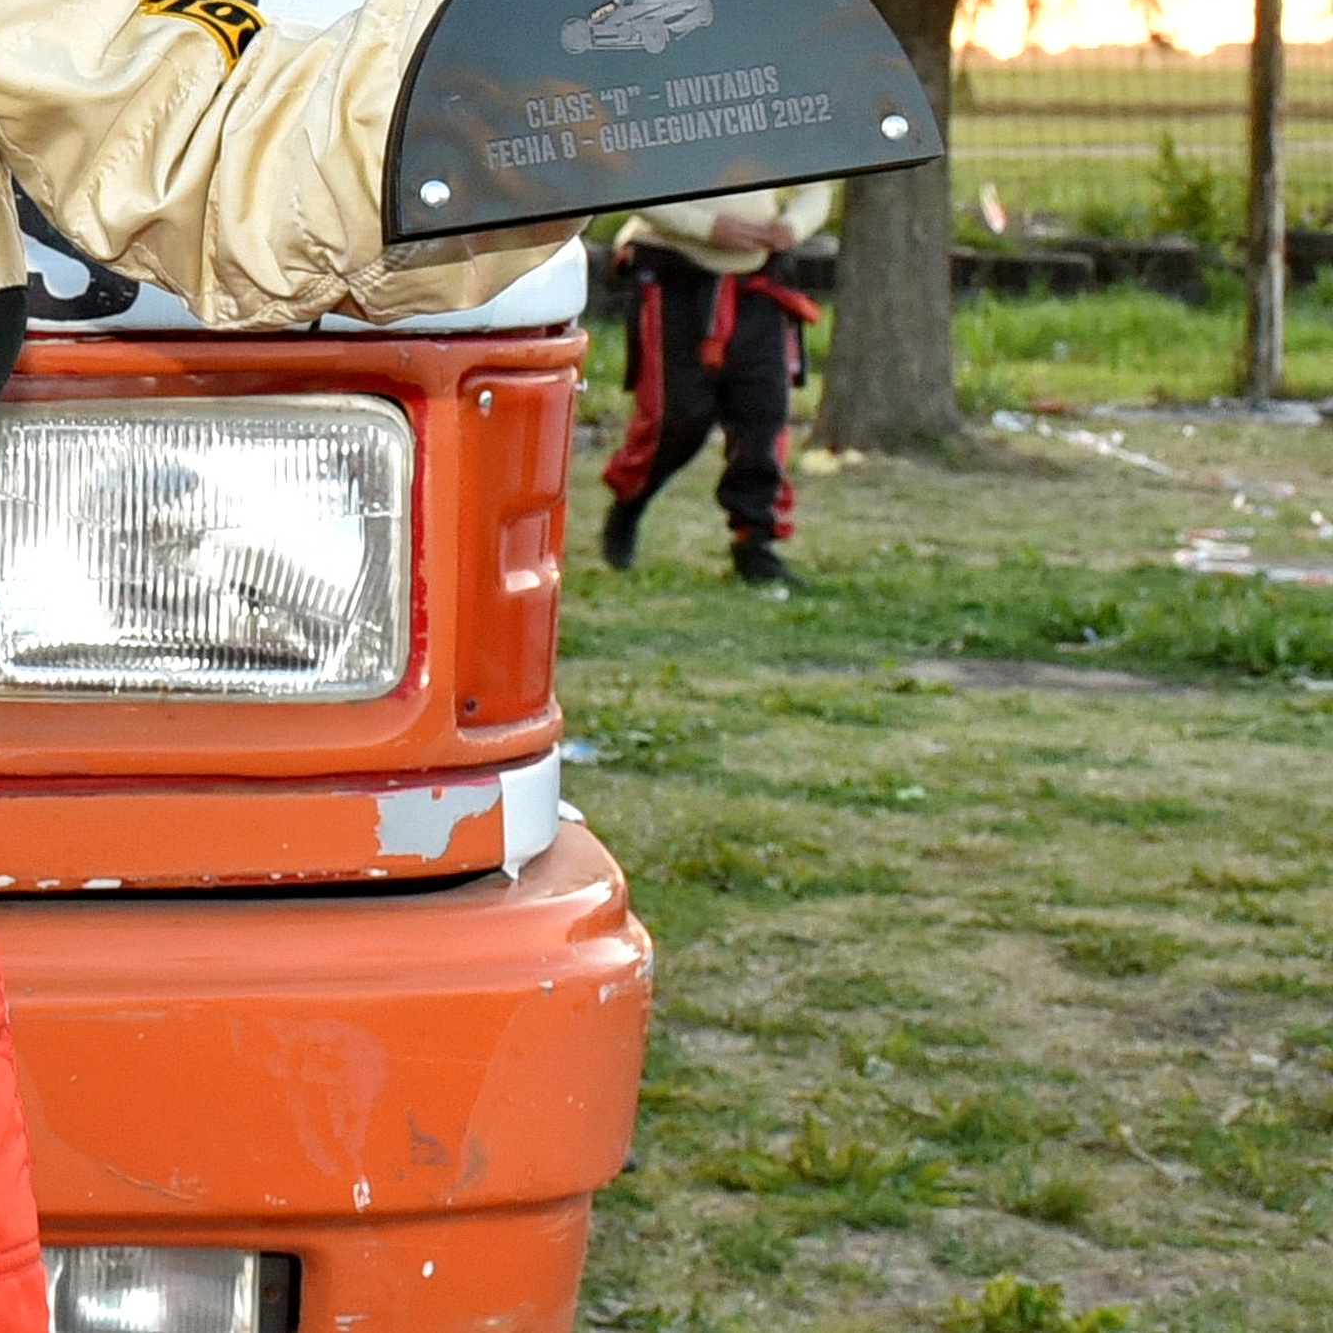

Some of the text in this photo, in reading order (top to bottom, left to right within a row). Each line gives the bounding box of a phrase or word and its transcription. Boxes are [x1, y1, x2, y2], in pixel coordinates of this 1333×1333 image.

[486, 131, 557, 170] FECHA
[561, 131, 578, 160] 8
[599, 98, 769, 154] GUALEGUAYCHÚ
[771, 93, 833, 129] 2022
[526, 92, 596, 129] CLASE
[664, 65, 780, 108] INVITADOS
